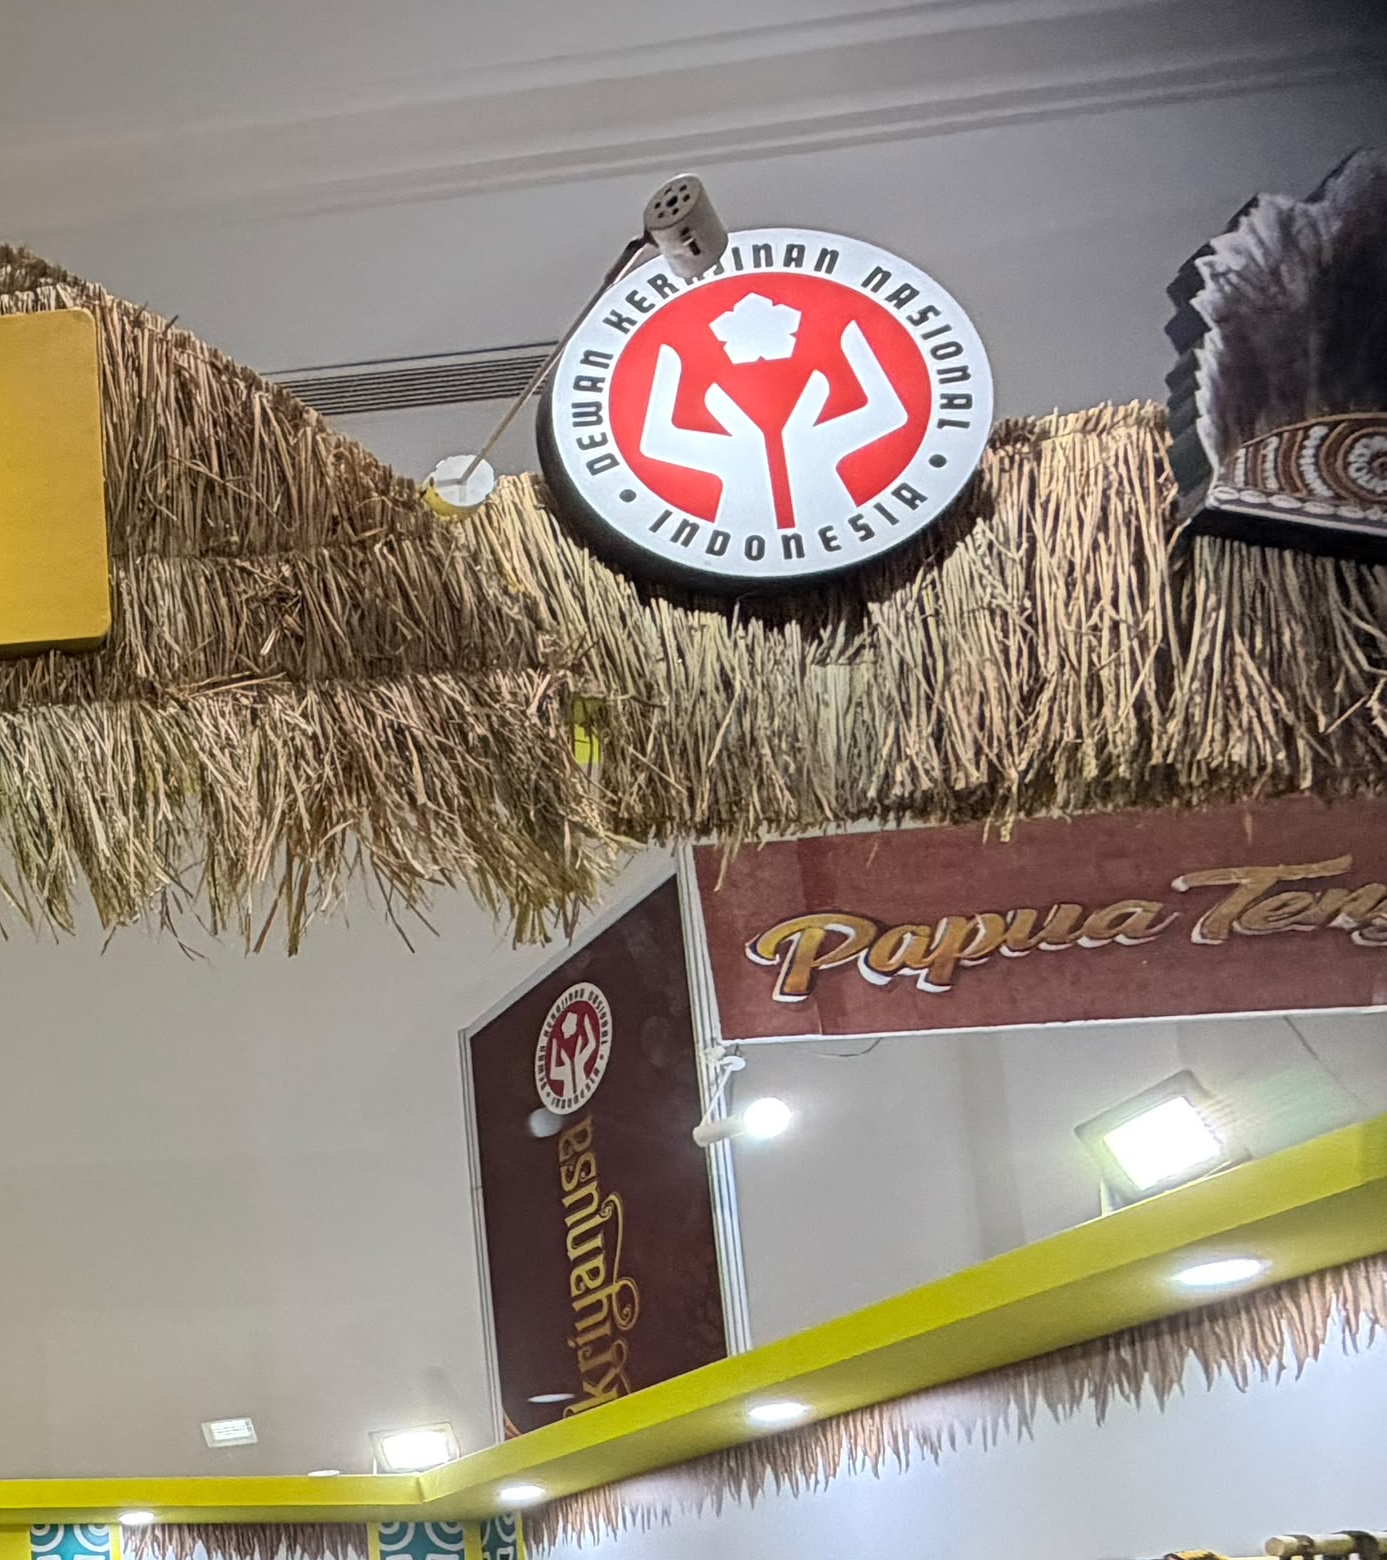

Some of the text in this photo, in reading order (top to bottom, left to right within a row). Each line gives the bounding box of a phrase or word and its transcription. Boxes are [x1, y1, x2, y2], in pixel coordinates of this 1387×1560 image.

[571, 242, 974, 476] DEWAN KERINAN NASIONAL
[647, 481, 929, 562] INDONESIA
[744, 899, 1180, 1004] Papua
